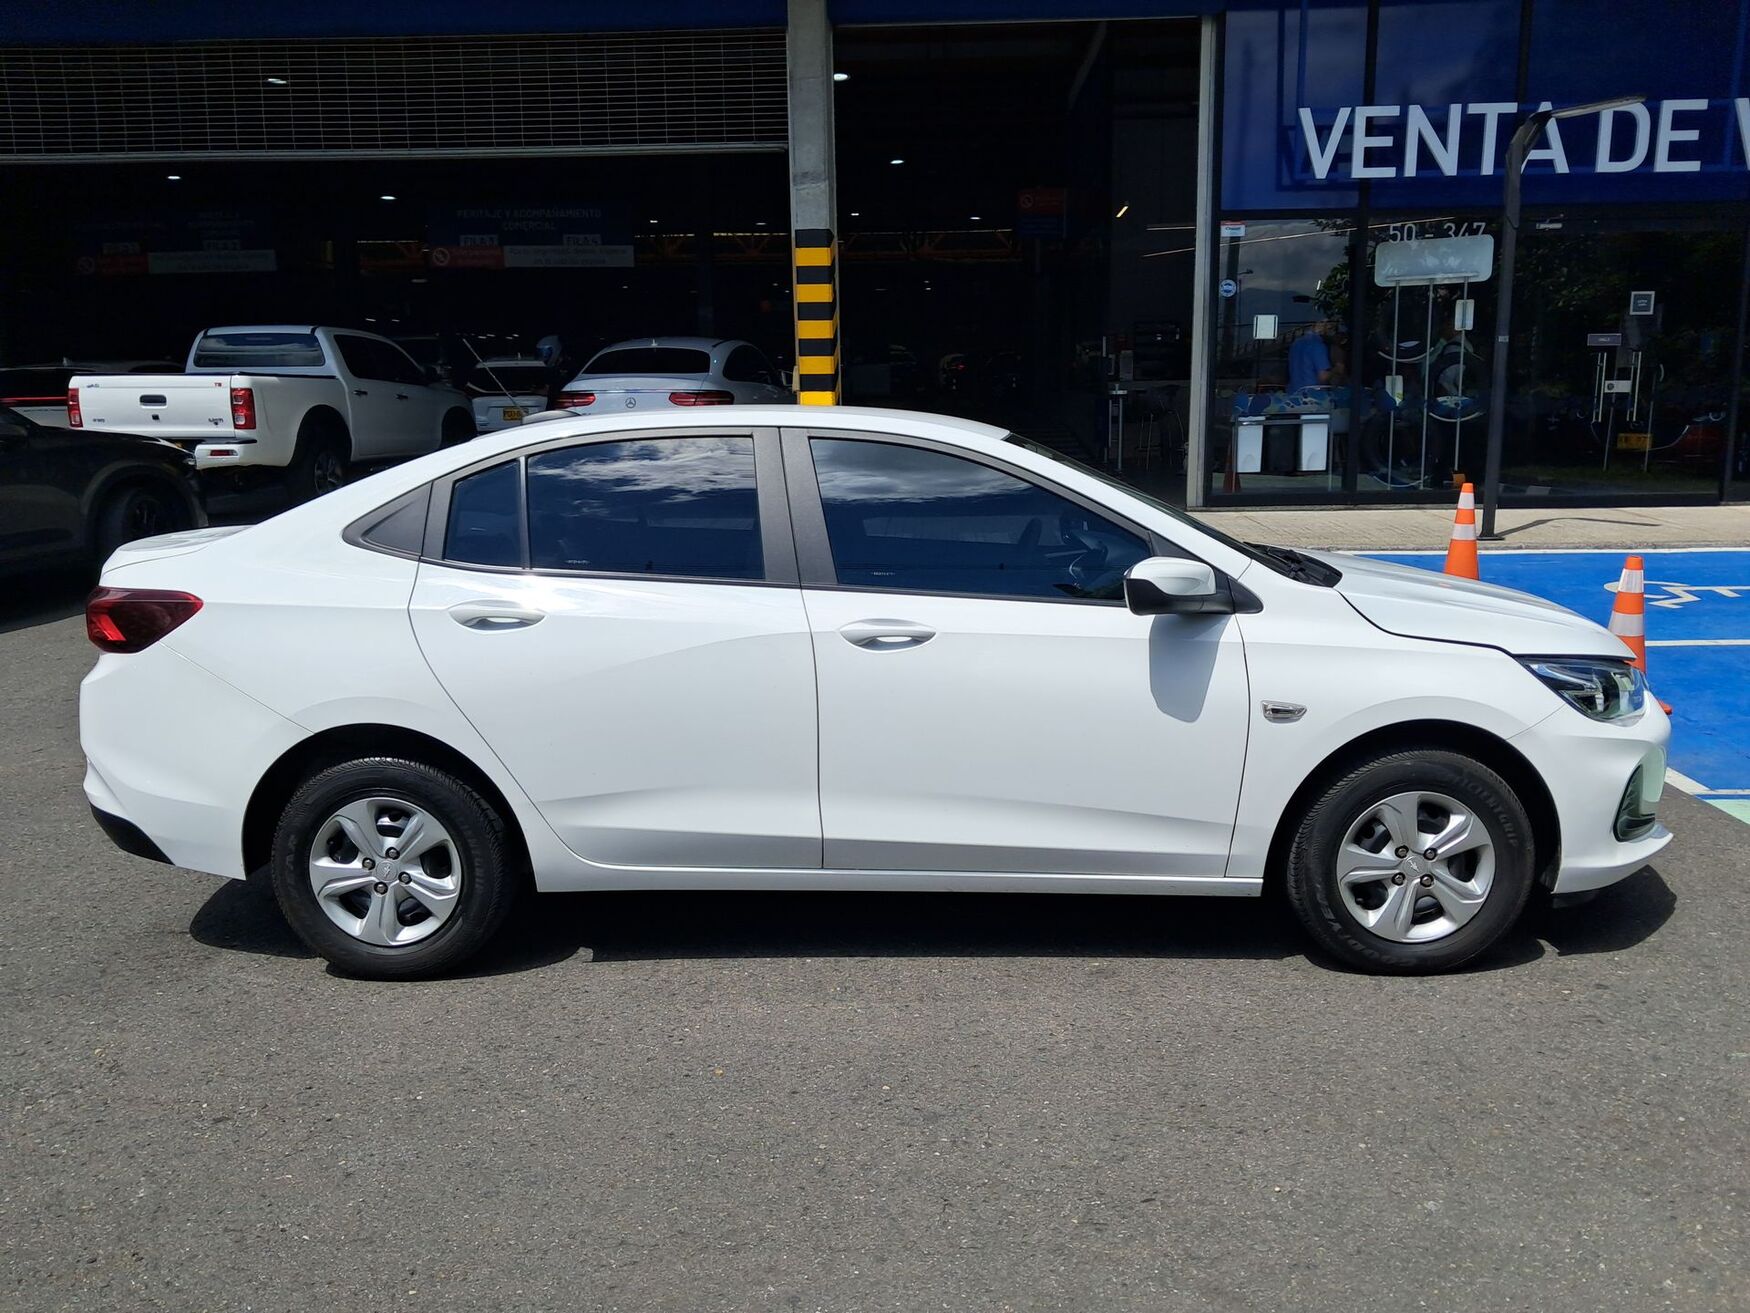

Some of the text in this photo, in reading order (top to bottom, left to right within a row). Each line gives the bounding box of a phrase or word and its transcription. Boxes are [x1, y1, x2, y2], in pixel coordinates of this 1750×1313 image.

[1297, 101, 1570, 179] VENTA
[1594, 98, 1709, 173] DE
[1388, 223, 1416, 243] 50
